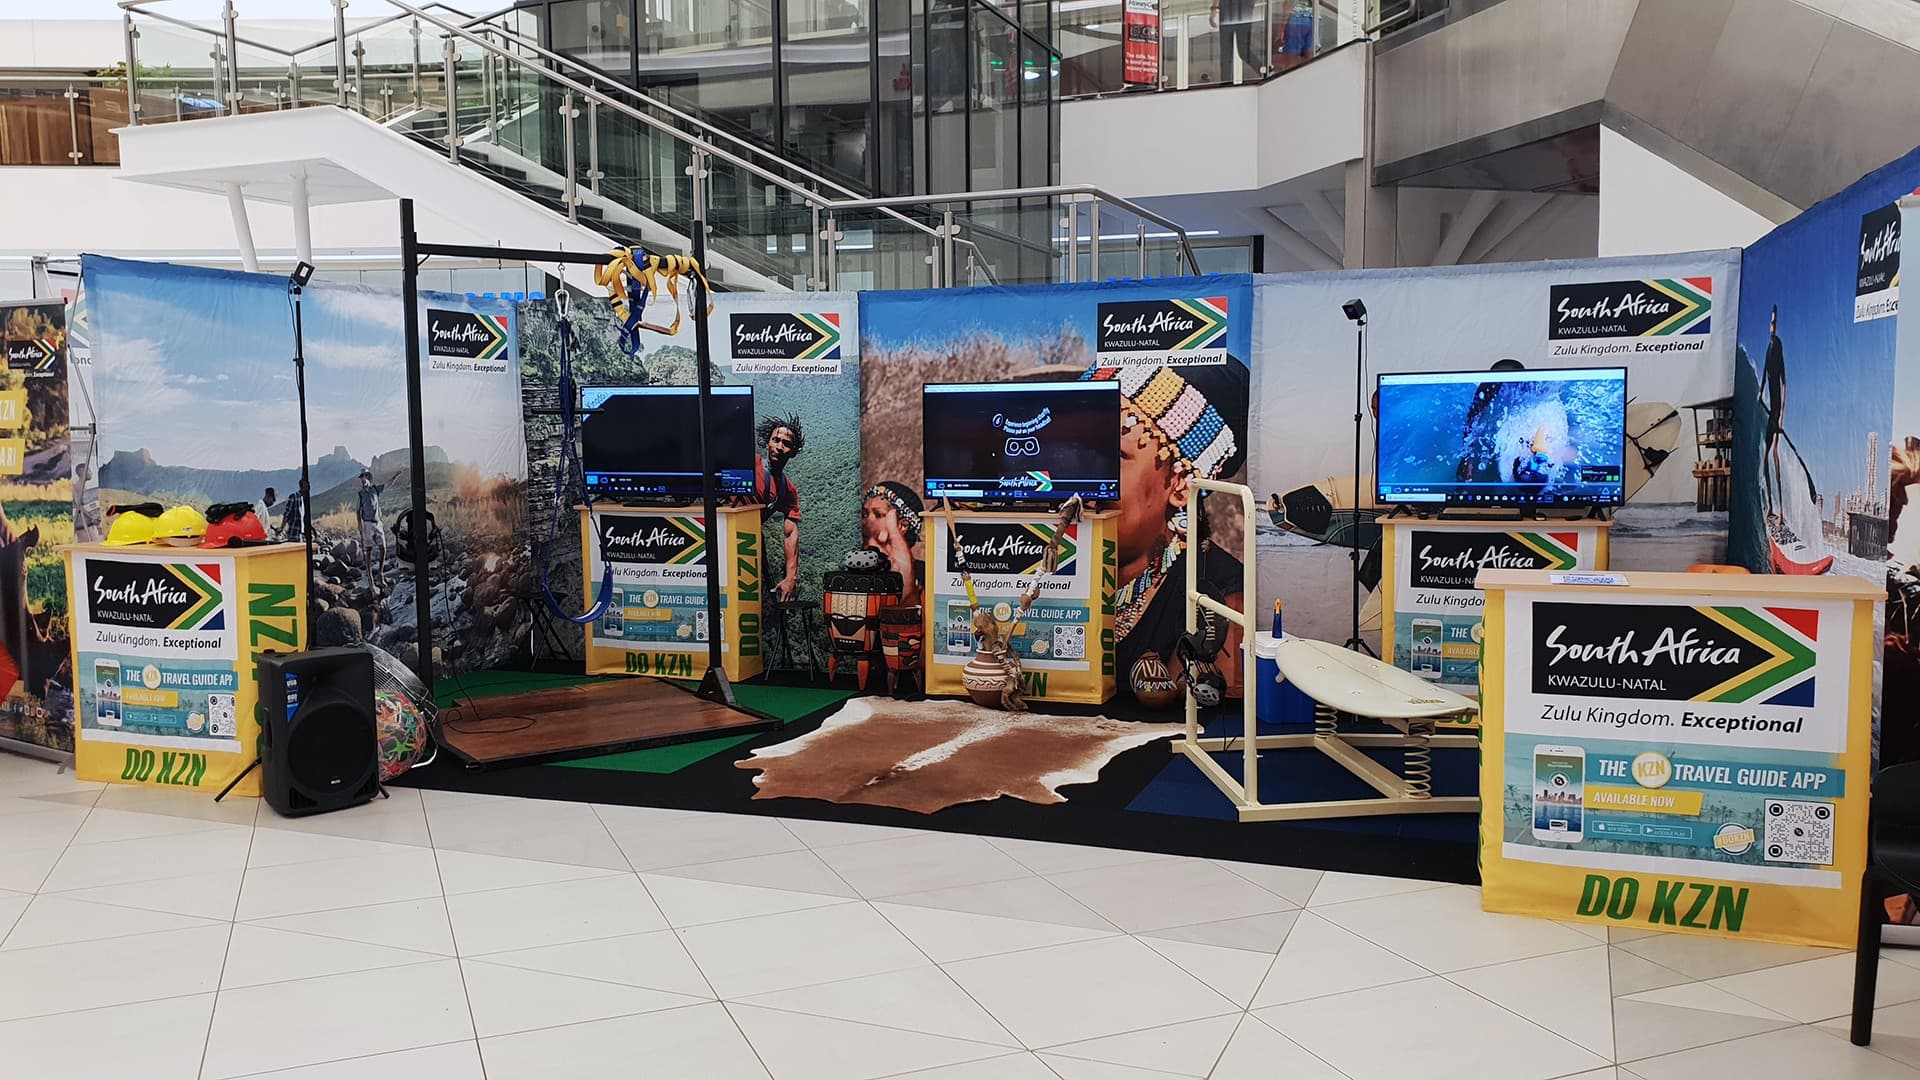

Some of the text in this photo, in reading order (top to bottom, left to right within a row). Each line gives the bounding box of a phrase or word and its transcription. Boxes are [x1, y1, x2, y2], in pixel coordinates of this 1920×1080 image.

[1861, 221, 1900, 270] South Afri
[1557, 293, 1669, 323] South Africa
[432, 320, 489, 342] South Africa
[1103, 311, 1193, 337] South Africa
[1558, 325, 1628, 335] KWAZULU-NATAL
[736, 323, 813, 345] South Africa
[737, 348, 785, 356] KWAZULU-NATAL
[1104, 340, 1160, 348] KWAZULU-NATAL
[1553, 340, 1704, 357] Zulu Kingdom. Exceptional
[432, 361, 446, 370] Zulu
[473, 364, 507, 374] Exceptional
[735, 363, 838, 375] Zulu Kingdom. Exceptional
[1101, 354, 1222, 368] Zulu Kingdom. Exceptional
[999, 476, 1019, 488] South
[605, 526, 685, 548] South Africa
[996, 534, 1043, 557] Africa
[954, 561, 1010, 570] KZULU-NATAL
[1419, 544, 1534, 571] South Africa
[623, 568, 660, 578] Kingdom.
[662, 569, 707, 580] Exceptiona
[1101, 539, 1117, 616] KZN
[1420, 575, 1475, 584] KWAZULU-N
[94, 575, 187, 606] South Africa
[1016, 580, 1071, 590] Excptional
[629, 594, 641, 603] THE
[659, 595, 683, 605] TRAVEL
[685, 596, 705, 605] GUIDE
[736, 532, 760, 657] DO KZN
[1416, 594, 1486, 608] Zulu Kingdo
[1013, 607, 1039, 618] TAVEL
[1041, 609, 1064, 619] GUIDE
[1064, 610, 1082, 619] APP
[96, 631, 117, 643] Zulu
[163, 636, 222, 650] Exceptional
[1450, 627, 1469, 638] THE
[1545, 624, 1741, 667] South Africa
[625, 652, 693, 677] DO KZN
[125, 669, 141, 683] THE
[162, 672, 191, 686] TRAVEL
[192, 673, 218, 687] GUIDE
[219, 674, 233, 687] APP
[1023, 672, 1048, 697] ZN
[1548, 674, 1667, 692] KWAZULU-NATAL
[1541, 704, 1803, 734] Zulu Kingdom. Exceptional
[121, 748, 155, 782] DO
[1598, 759, 1827, 790] THE KZN TRAVEL GUIDE APP
[1593, 791, 1675, 808] AVAILABLE NOW
[1576, 874, 1750, 932] DO KZN
